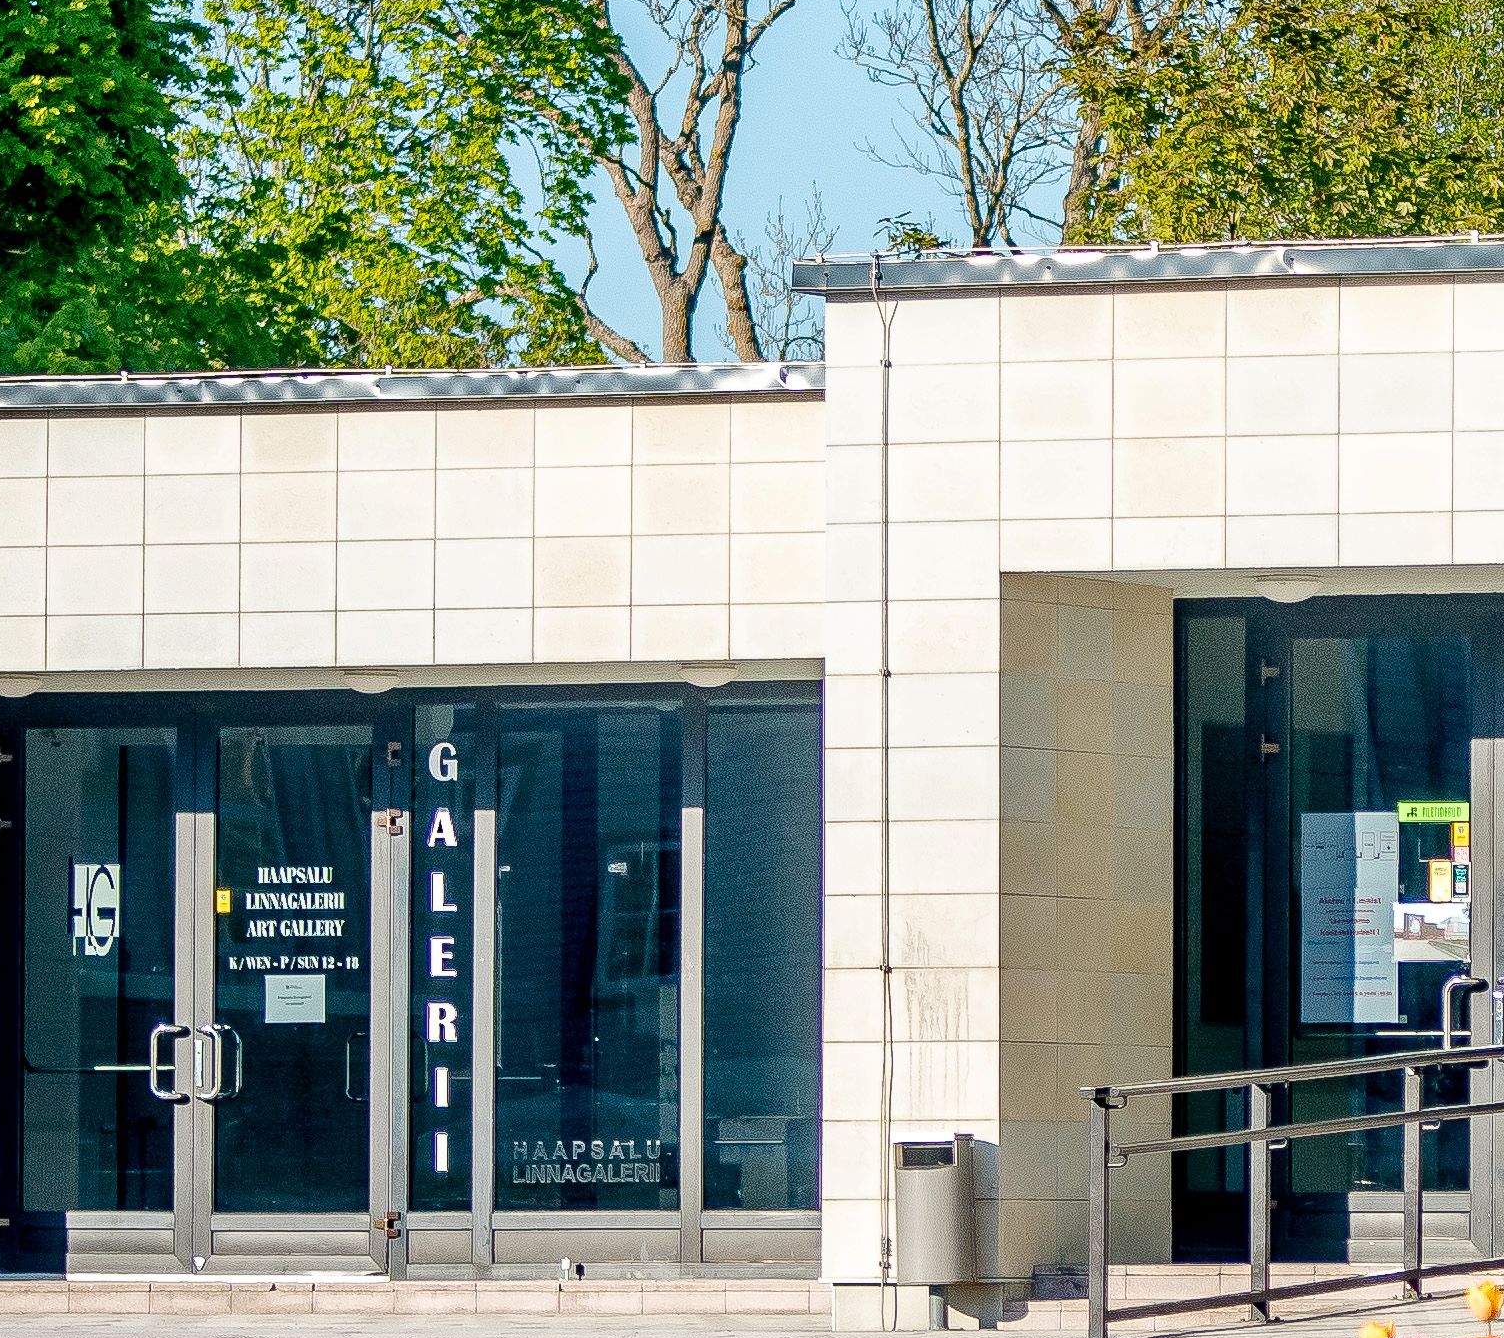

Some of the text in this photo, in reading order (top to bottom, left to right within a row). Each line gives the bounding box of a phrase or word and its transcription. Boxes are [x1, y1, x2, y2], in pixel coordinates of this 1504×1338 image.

[257, 866, 333, 884] HAAPSALU
[245, 892, 345, 910] LINNAGALERII
[246, 919, 345, 937] ART GALLERY
[322, 956, 335, 970] 12
[345, 956, 360, 970] 18
[426, 741, 459, 1174] GALERII
[512, 1140, 661, 1160] HAAPSALU
[512, 1162, 661, 1184] LINNAGALERII
